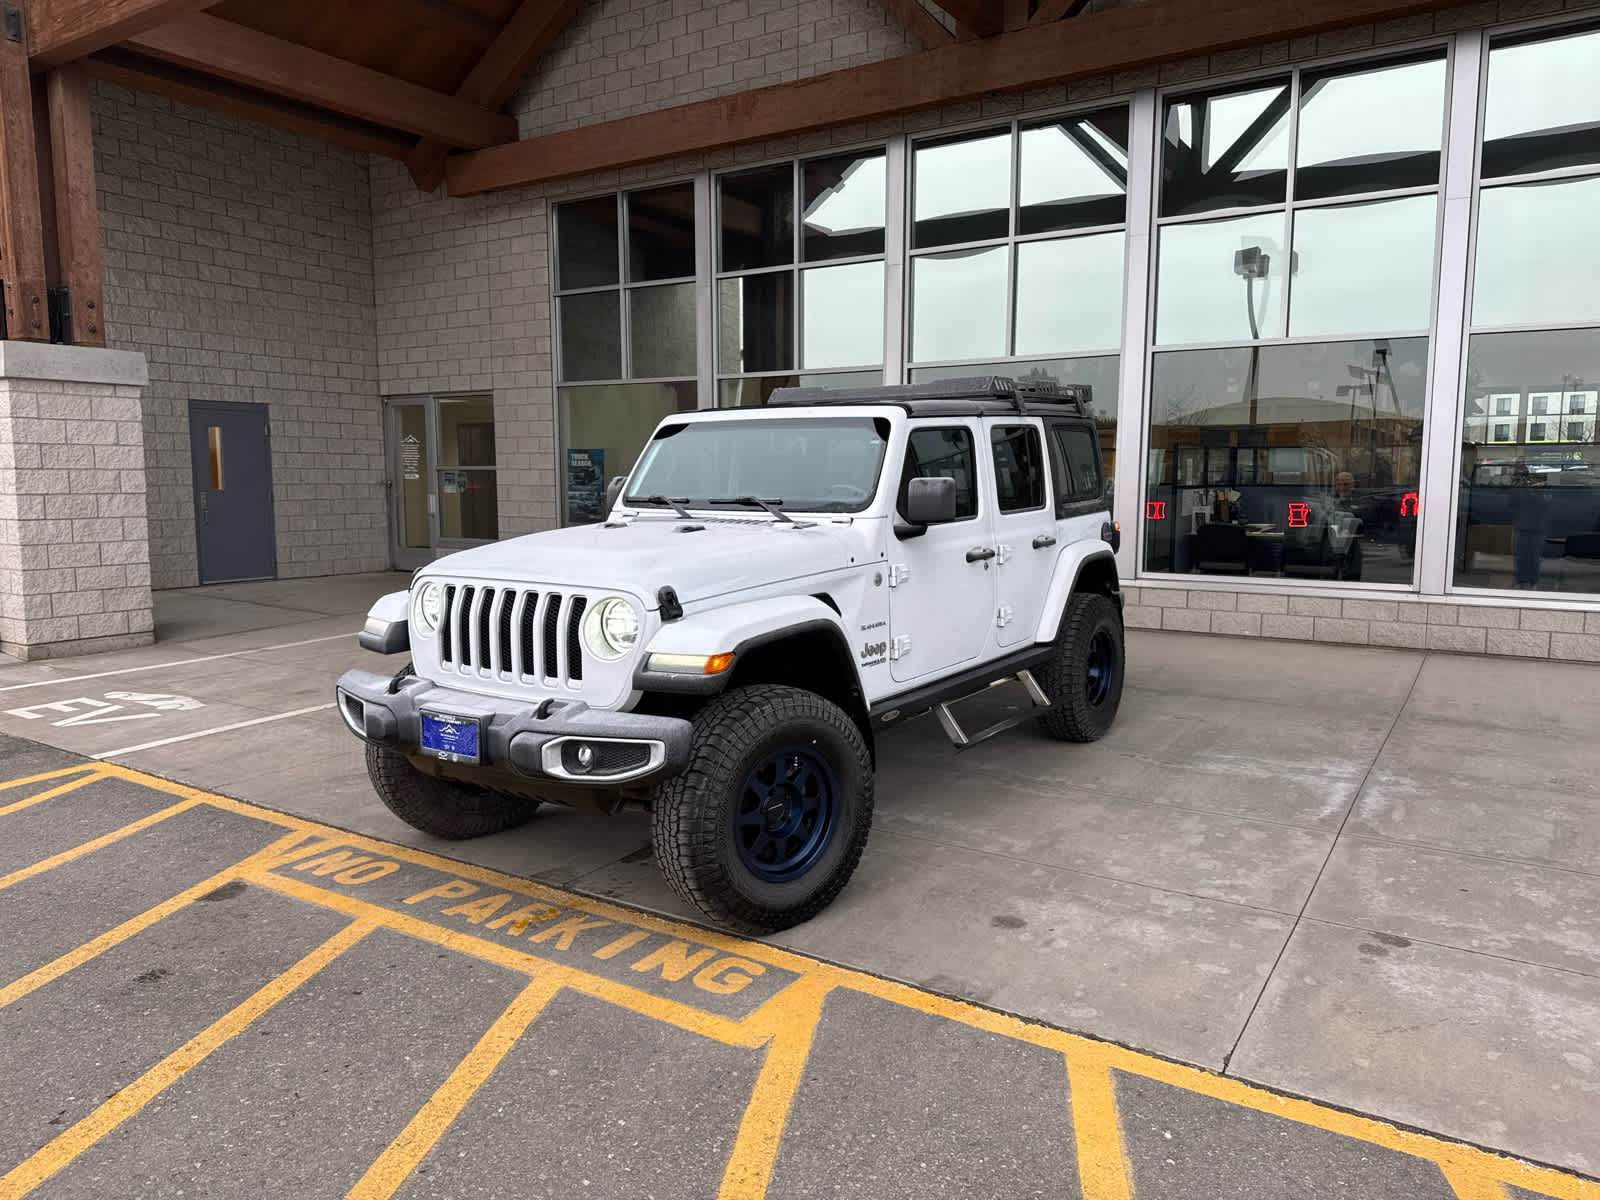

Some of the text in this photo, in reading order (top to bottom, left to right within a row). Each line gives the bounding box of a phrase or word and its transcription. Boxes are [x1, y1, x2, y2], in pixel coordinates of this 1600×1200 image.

[860, 641, 887, 659] Jeep
[0, 697, 162, 727] EV
[292, 850, 767, 995] NO PARKING
